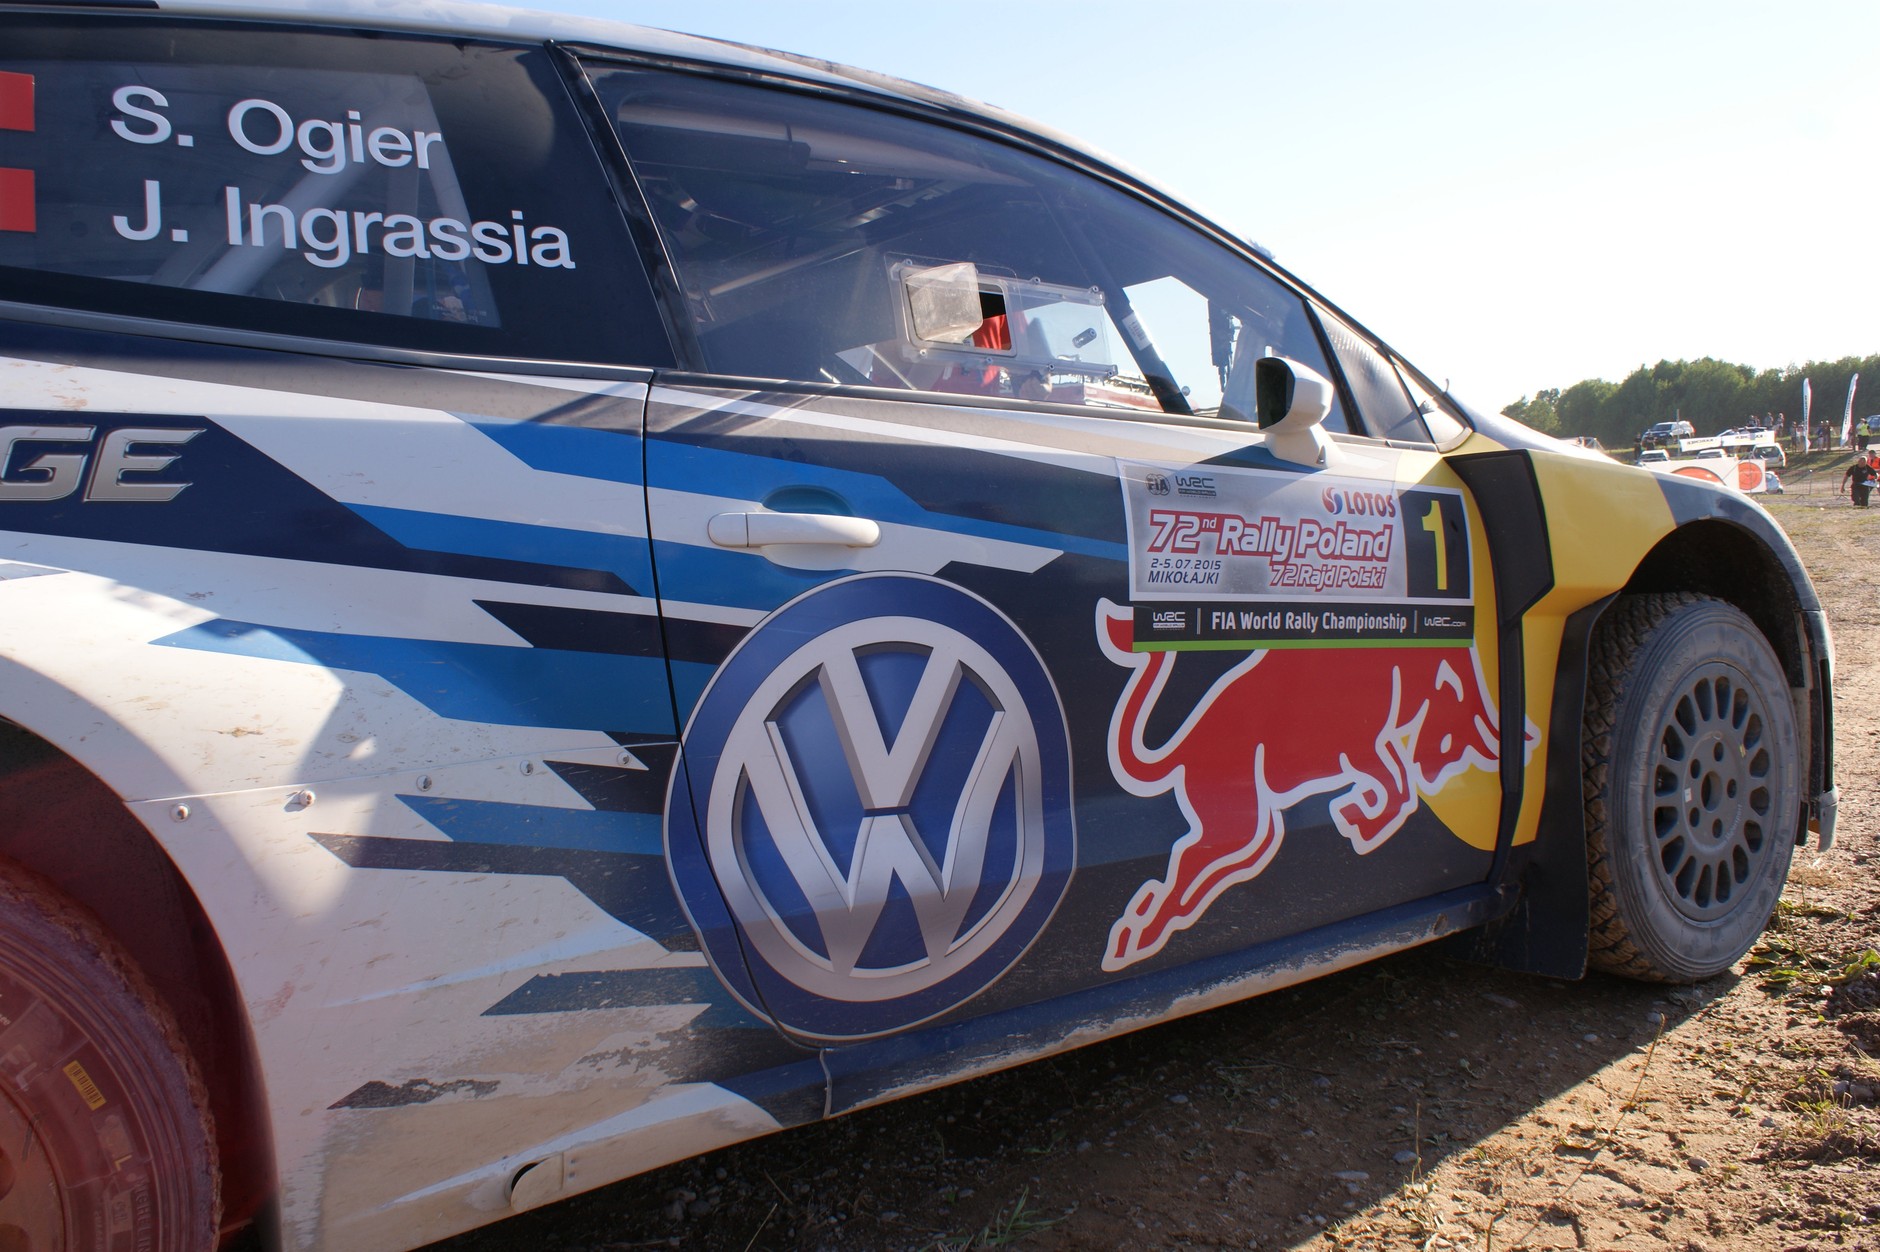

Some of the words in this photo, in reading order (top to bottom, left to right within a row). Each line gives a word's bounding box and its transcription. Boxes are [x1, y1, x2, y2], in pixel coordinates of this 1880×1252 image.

[110, 85, 193, 147] S.
[227, 98, 442, 175] Ogier
[112, 179, 189, 243] J.
[224, 185, 576, 269] Ingrassia
[1175, 475, 1216, 489] WRC
[1343, 490, 1396, 518] LOTOS
[1218, 514, 1294, 565] Rally
[1296, 519, 1392, 561] Poland
[1421, 500, 1448, 591] 1
[1147, 570, 1219, 585] MIKOŁAJKI
[1150, 558, 1222, 570] 2-5.07.2015
[1271, 563, 1298, 586] 72
[1298, 564, 1337, 592] Rajd
[1337, 565, 1386, 588] Polski
[1152, 611, 1186, 622] WRC
[1211, 611, 1237, 631] FIA
[1239, 611, 1282, 631] World
[1285, 611, 1319, 634] Rally
[1322, 611, 1408, 634] Championship
